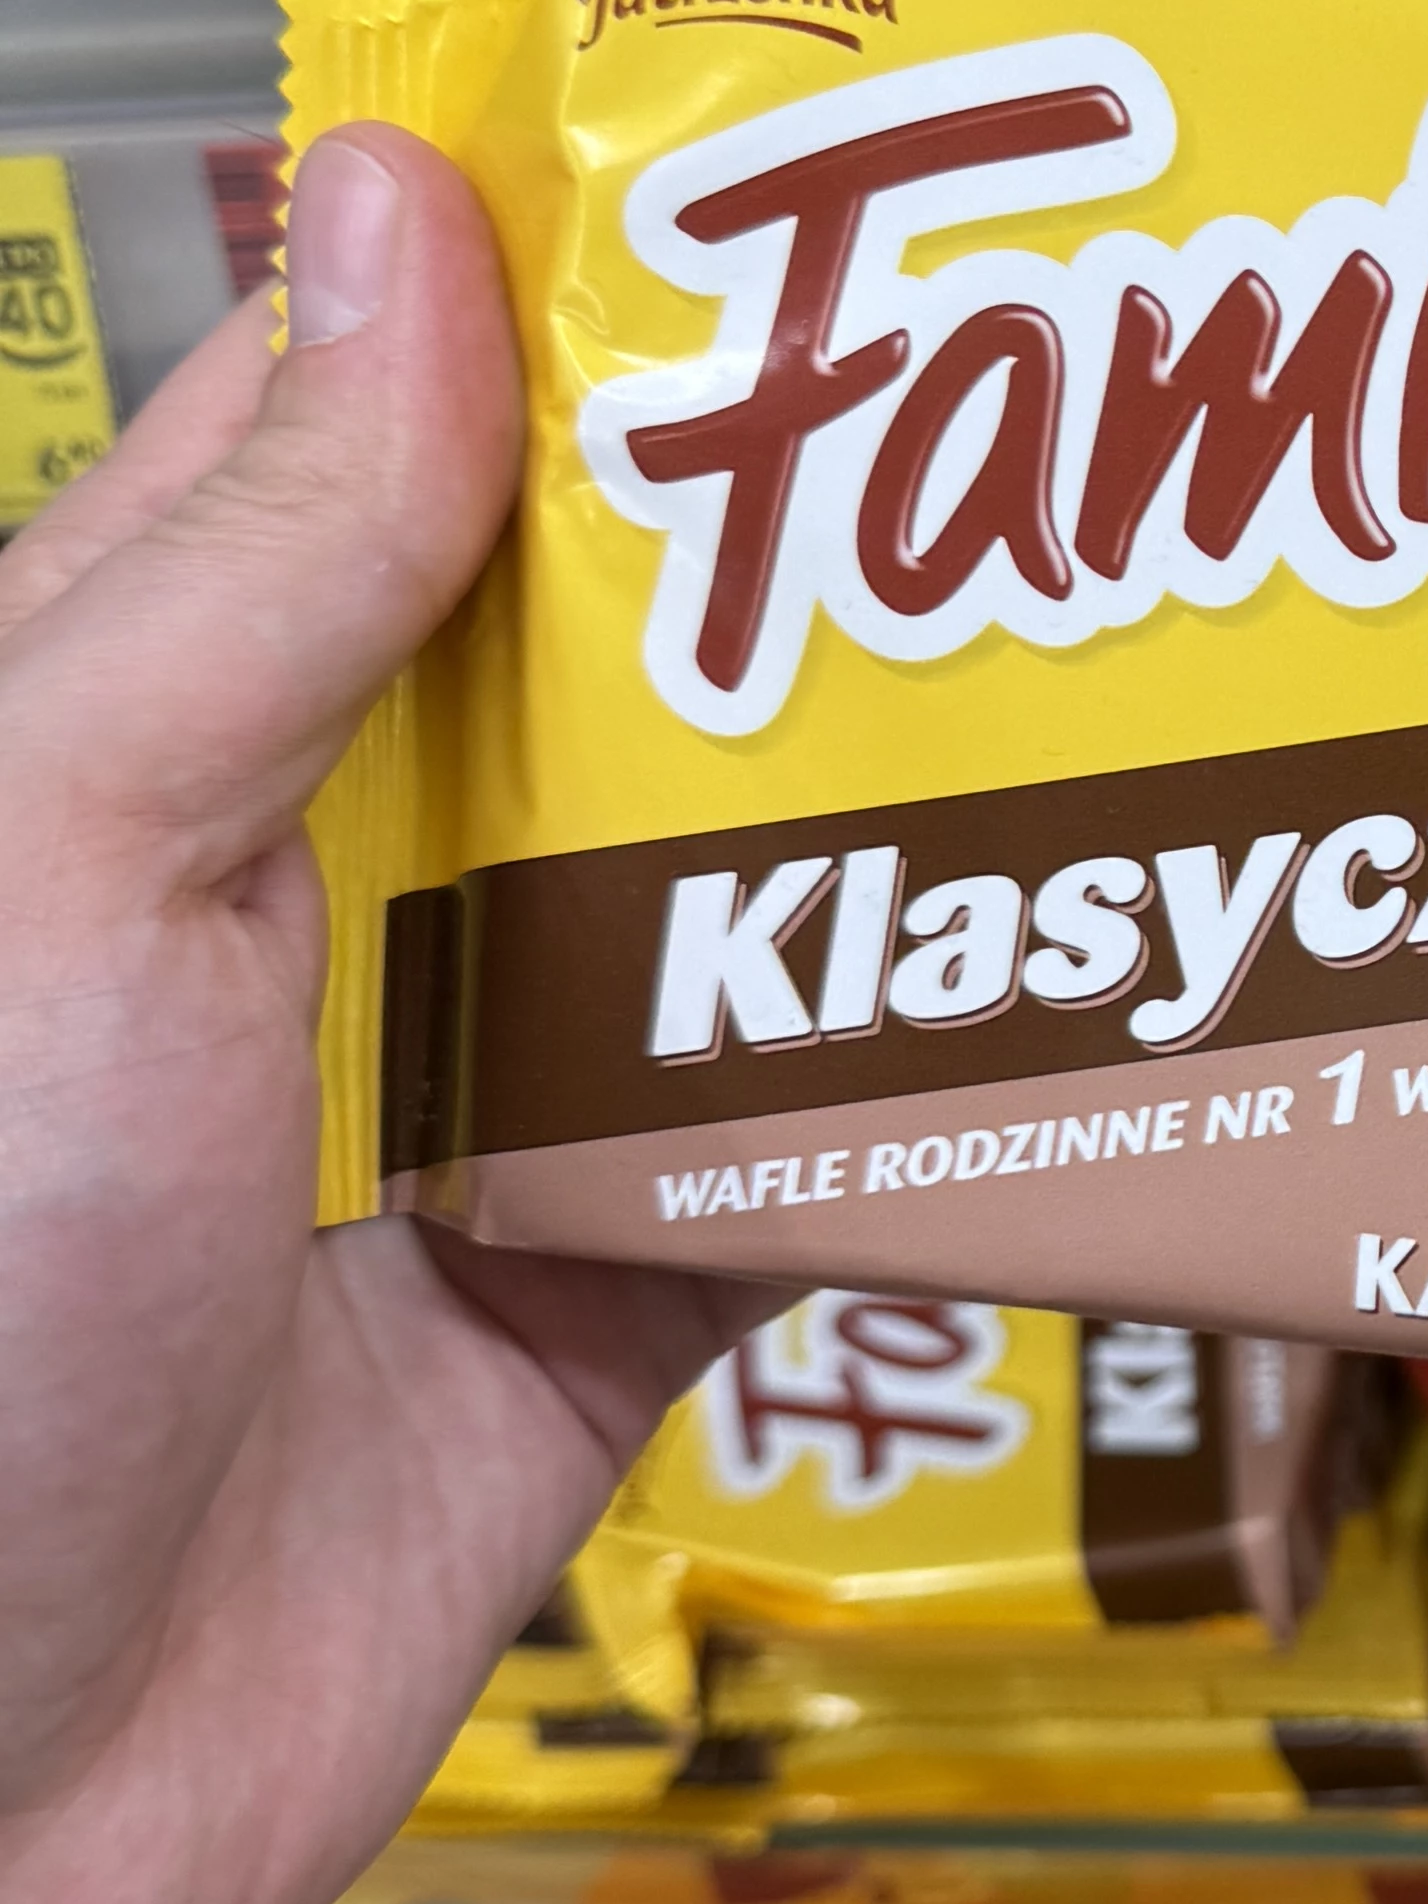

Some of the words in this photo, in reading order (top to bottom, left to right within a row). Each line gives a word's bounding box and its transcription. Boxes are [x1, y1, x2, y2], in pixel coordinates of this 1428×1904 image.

[655, 1149, 847, 1223] WAFLE
[863, 1100, 1188, 1194] RODZINNE
[1202, 1083, 1294, 1146] NR
[1318, 1050, 1367, 1127] 1
